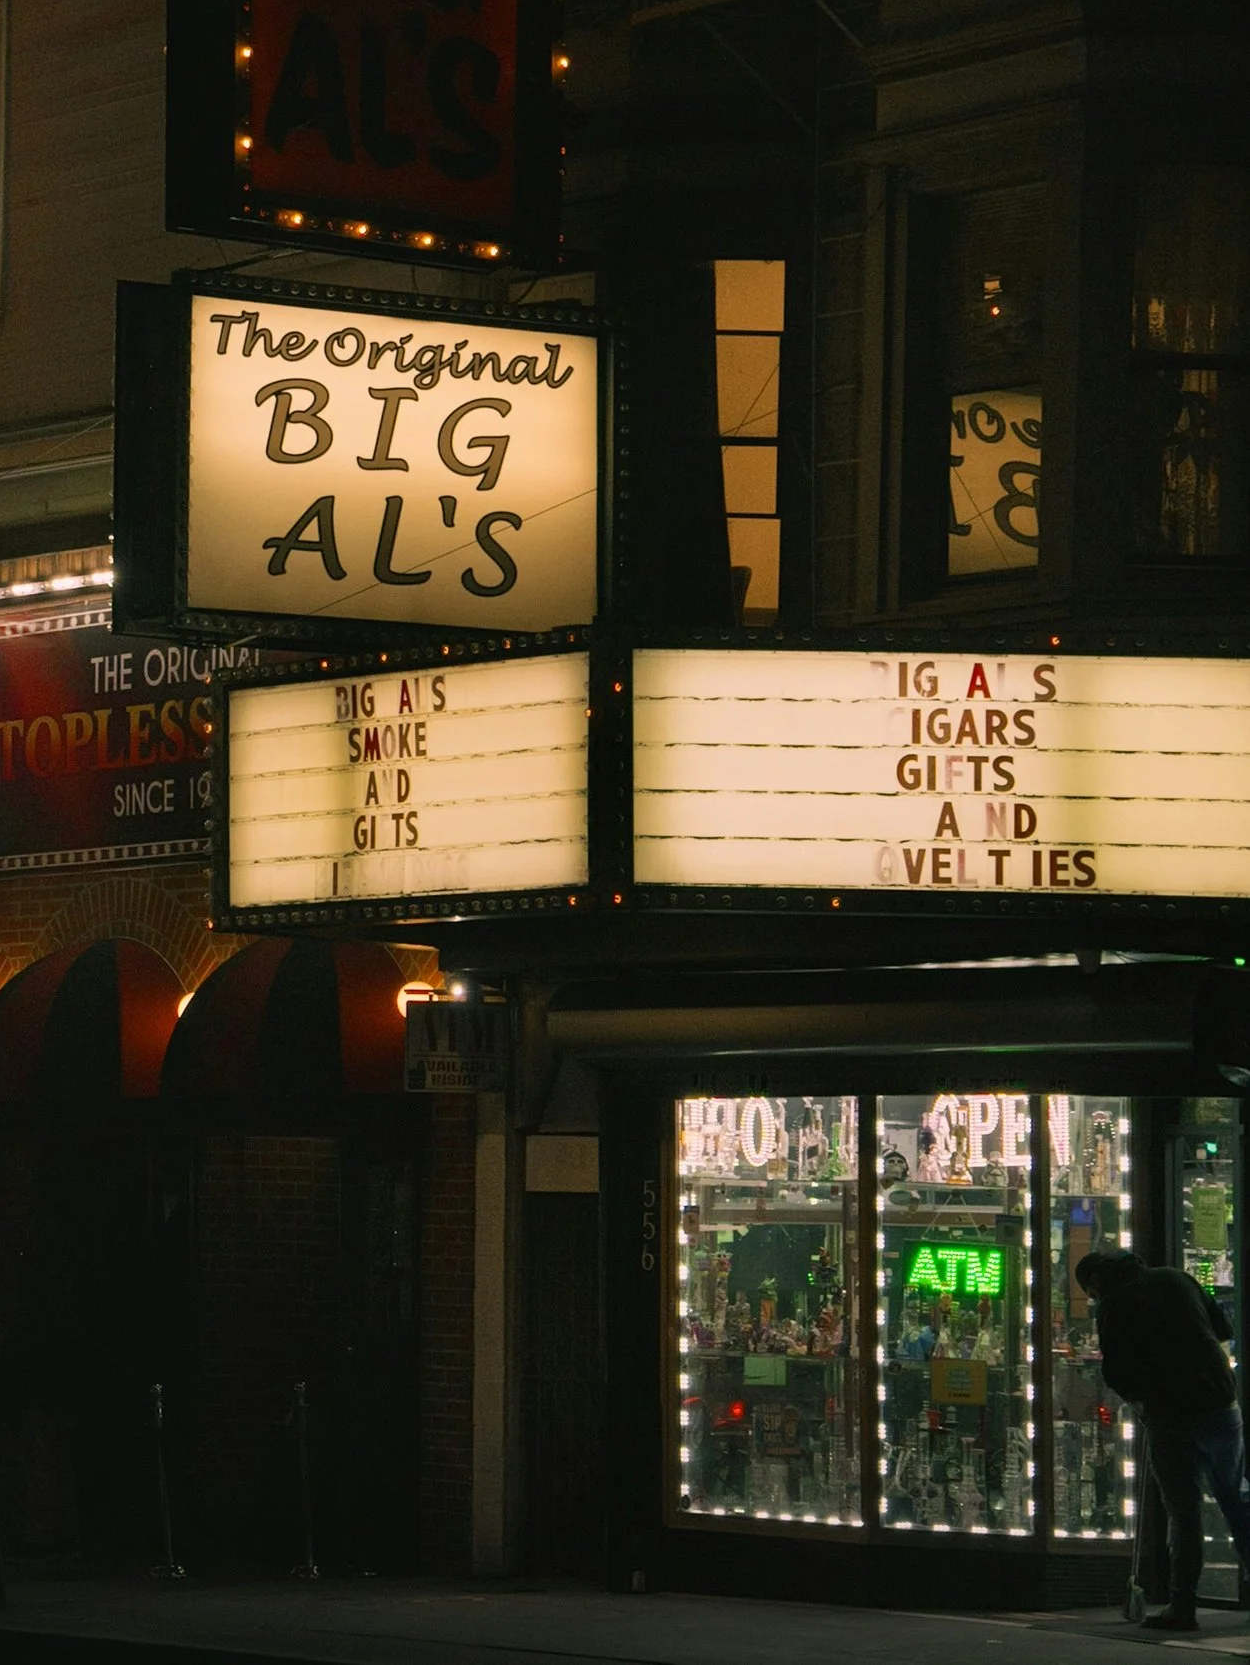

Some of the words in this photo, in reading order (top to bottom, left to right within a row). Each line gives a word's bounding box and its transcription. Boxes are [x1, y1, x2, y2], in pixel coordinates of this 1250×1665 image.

[264, 9, 501, 181] AL'S
[210, 311, 318, 362] The
[324, 327, 574, 390] Original
[255, 378, 513, 491] BIG
[262, 495, 523, 597] AL'S
[90, 652, 133, 694] THE
[335, 682, 375, 720] BIG
[348, 721, 427, 764] SMOKE
[896, 755, 1016, 792] GIFTS
[112, 779, 175, 818] SINCE
[641, 1179, 657, 1271] 556
[909, 1247, 1001, 1292] ATM
